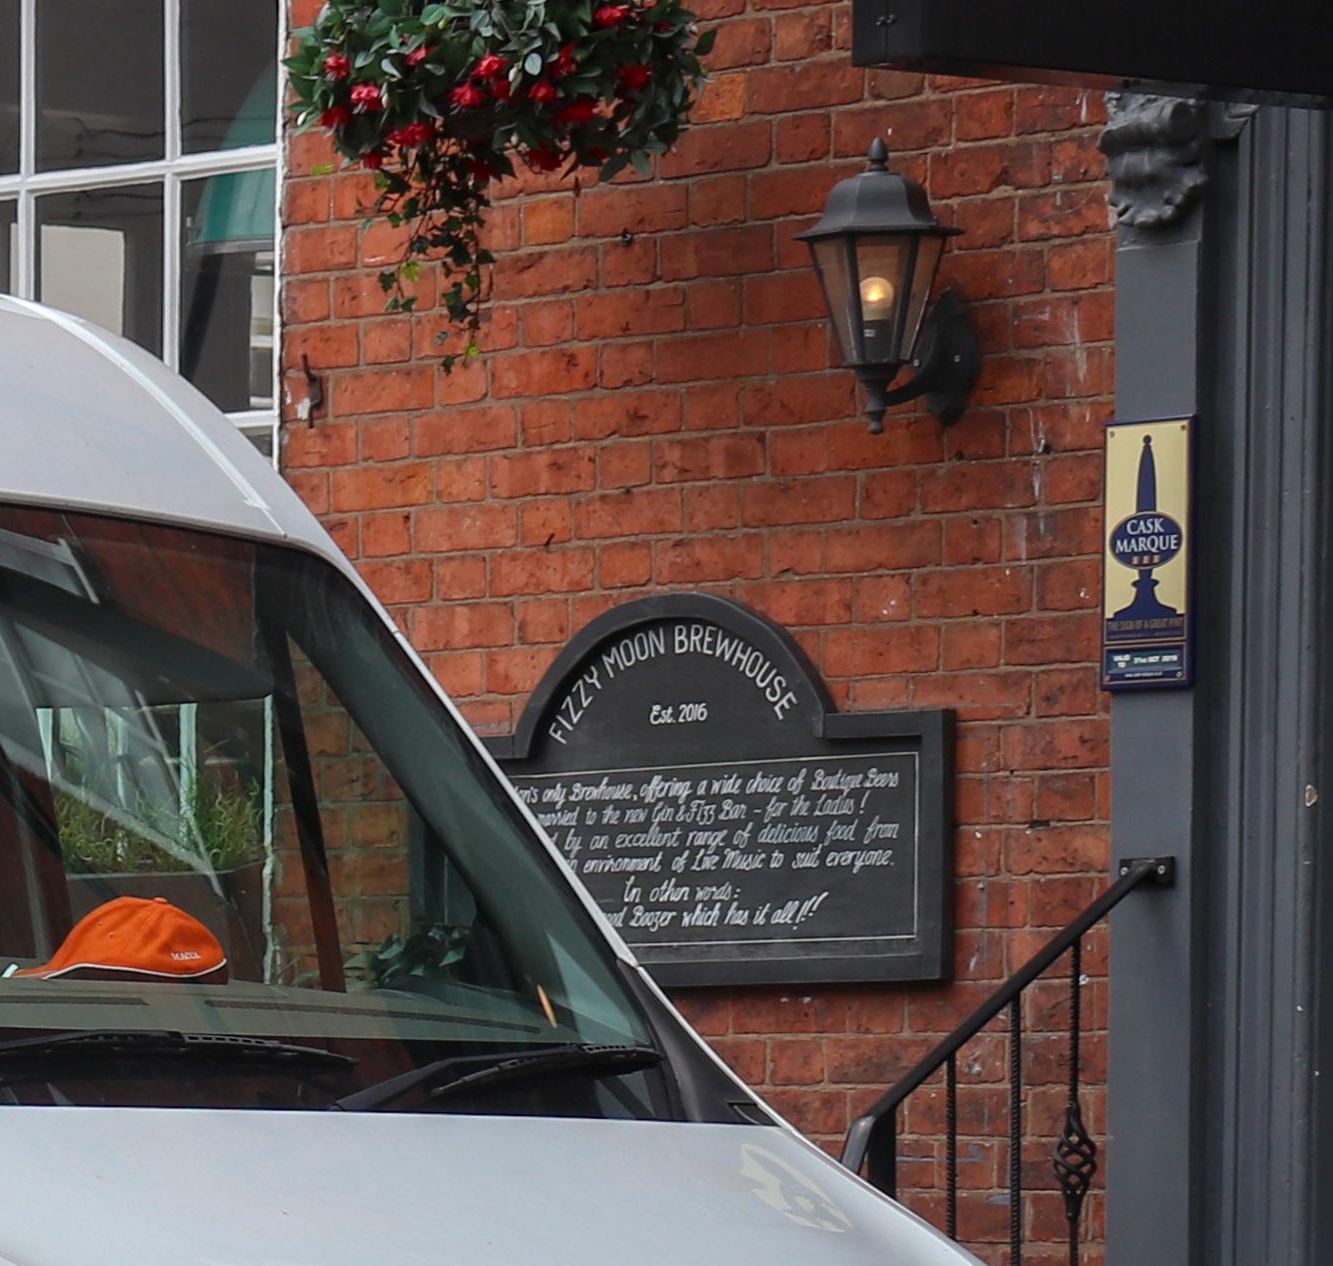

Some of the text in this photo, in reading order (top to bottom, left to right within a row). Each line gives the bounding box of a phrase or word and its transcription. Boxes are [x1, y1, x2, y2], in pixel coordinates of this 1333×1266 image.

[1125, 517, 1165, 536] CASK
[1114, 533, 1179, 554] MARQUE
[548, 623, 798, 745] FIZZY MOON BREWHOUSE
[649, 702, 708, 725] Est. 2016
[541, 782, 568, 809] only
[639, 774, 693, 804] offering
[696, 779, 707, 795] a
[710, 772, 741, 796] wide
[745, 770, 784, 795] choice
[787, 767, 808, 796] of
[809, 768, 864, 797] Boutique
[862, 767, 900, 788] Beers
[585, 807, 596, 825] to
[600, 803, 621, 825] the
[623, 806, 651, 825] new
[651, 801, 675, 828] Gin
[717, 798, 748, 821] Bar
[763, 796, 787, 824] for
[789, 794, 811, 816] the
[564, 827, 583, 859] by
[589, 834, 609, 850] an
[614, 823, 684, 849] excellent
[685, 829, 729, 855] range
[733, 821, 754, 849] of
[757, 821, 819, 845] delicious
[823, 818, 859, 846] food
[863, 815, 900, 845] from
[583, 851, 664, 874] environment
[671, 849, 690, 874] of
[690, 848, 720, 871] Live
[721, 847, 767, 871] Music
[769, 849, 785, 869] to
[791, 844, 823, 870] suit
[825, 847, 895, 874] everyone.
[649, 877, 690, 903] other
[695, 881, 742, 902] words:
[629, 905, 678, 933] Boozer
[681, 902, 720, 928] which
[723, 901, 749, 925] has
[752, 902, 771, 925] it
